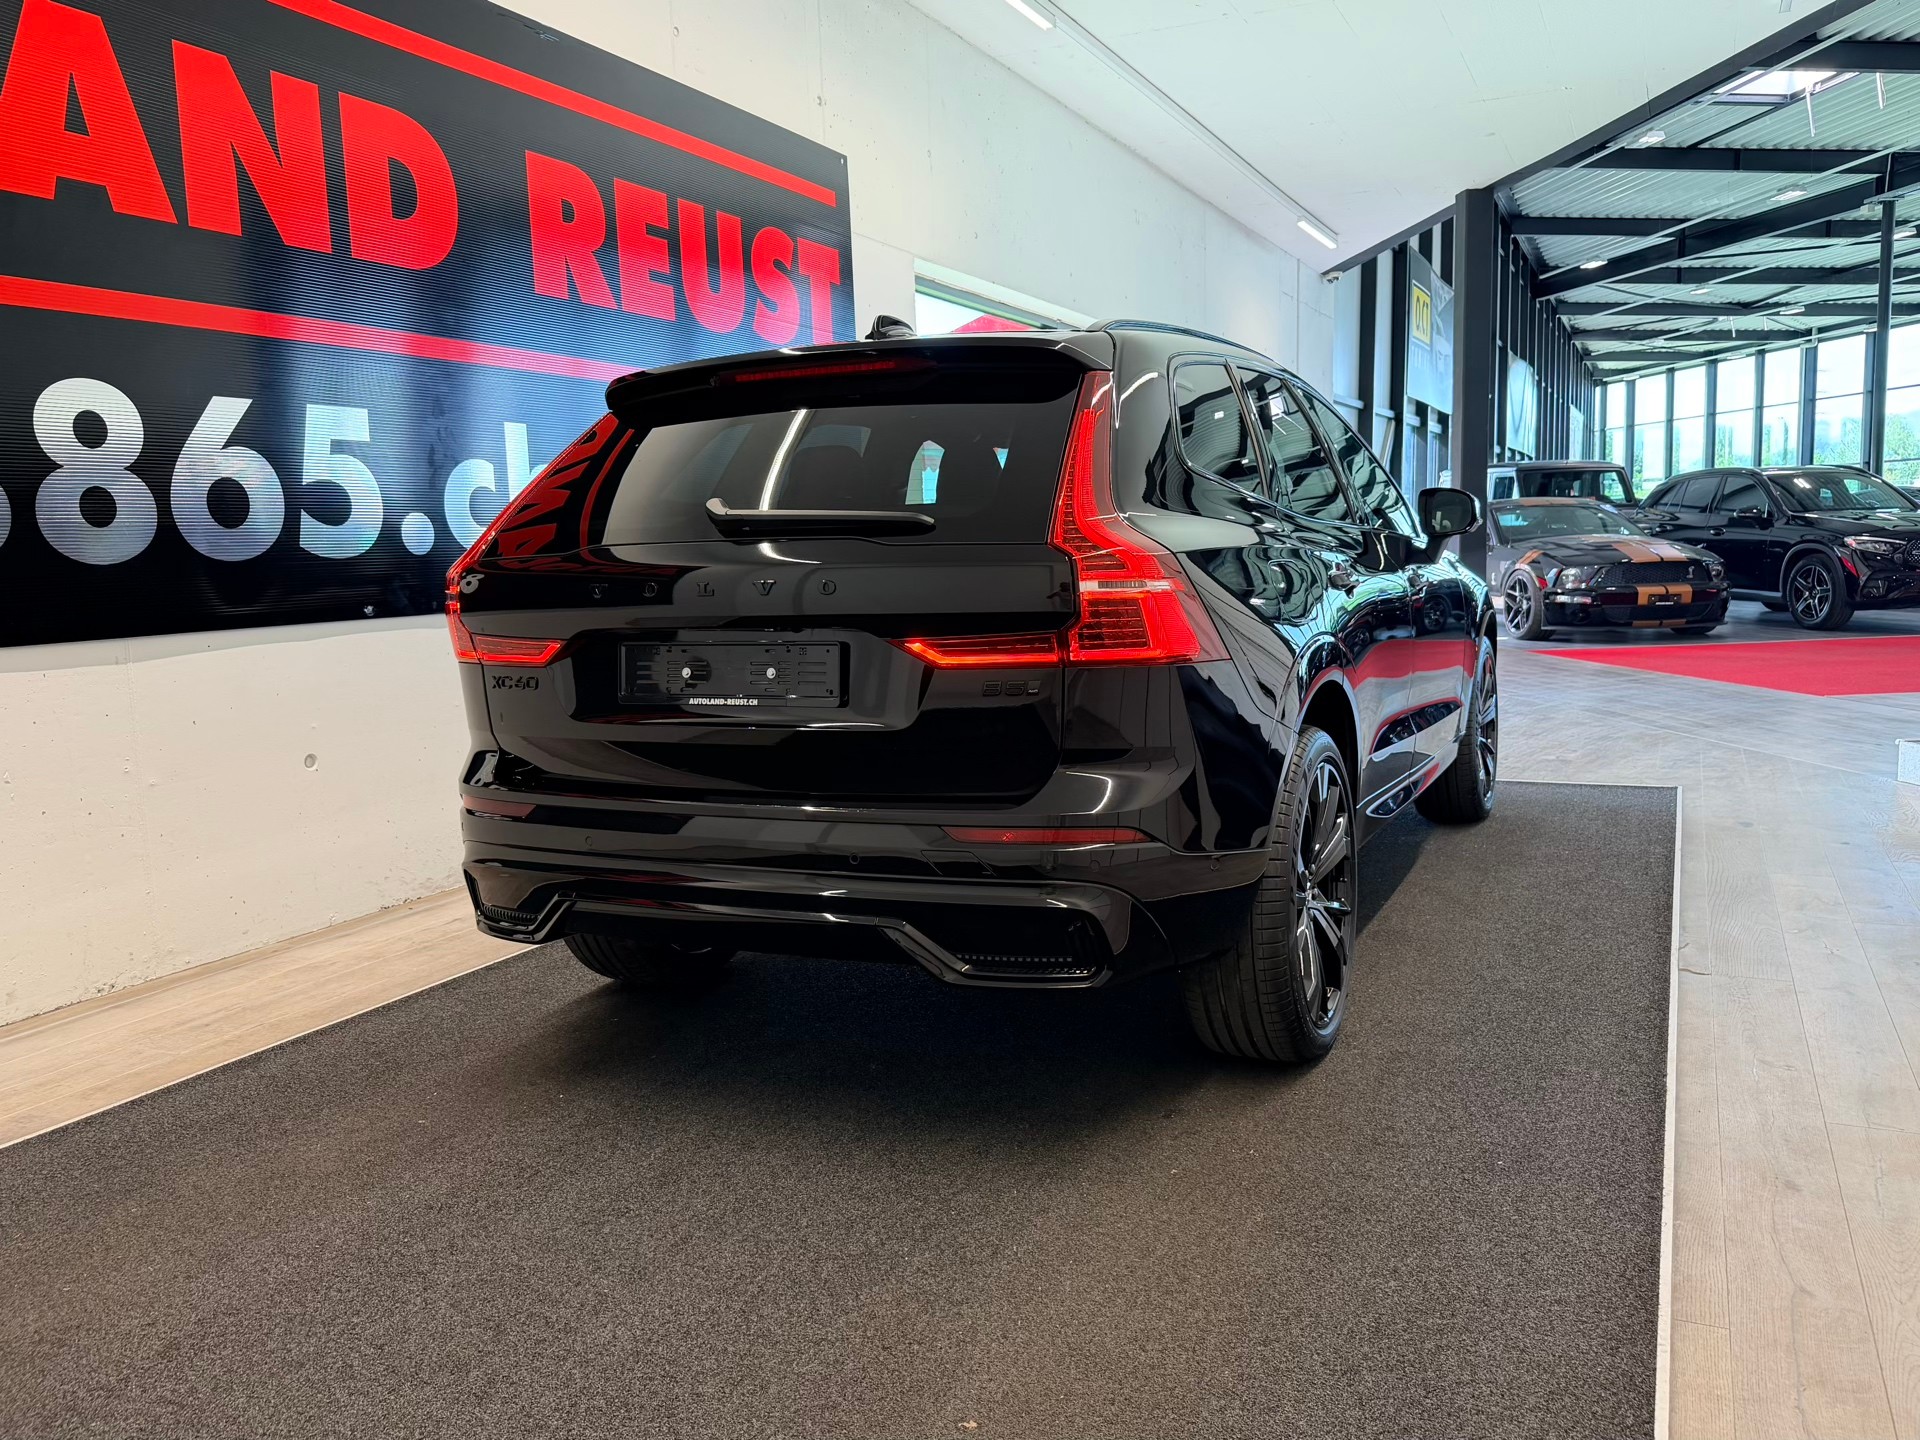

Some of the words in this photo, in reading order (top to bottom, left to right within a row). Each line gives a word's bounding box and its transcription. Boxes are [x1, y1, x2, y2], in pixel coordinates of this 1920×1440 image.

[525, 150, 840, 345] REUST
[589, 579, 837, 599] VOLVO
[491, 675, 539, 691] XC60
[688, 697, 759, 706] AUTOLAND-REUST.CH
